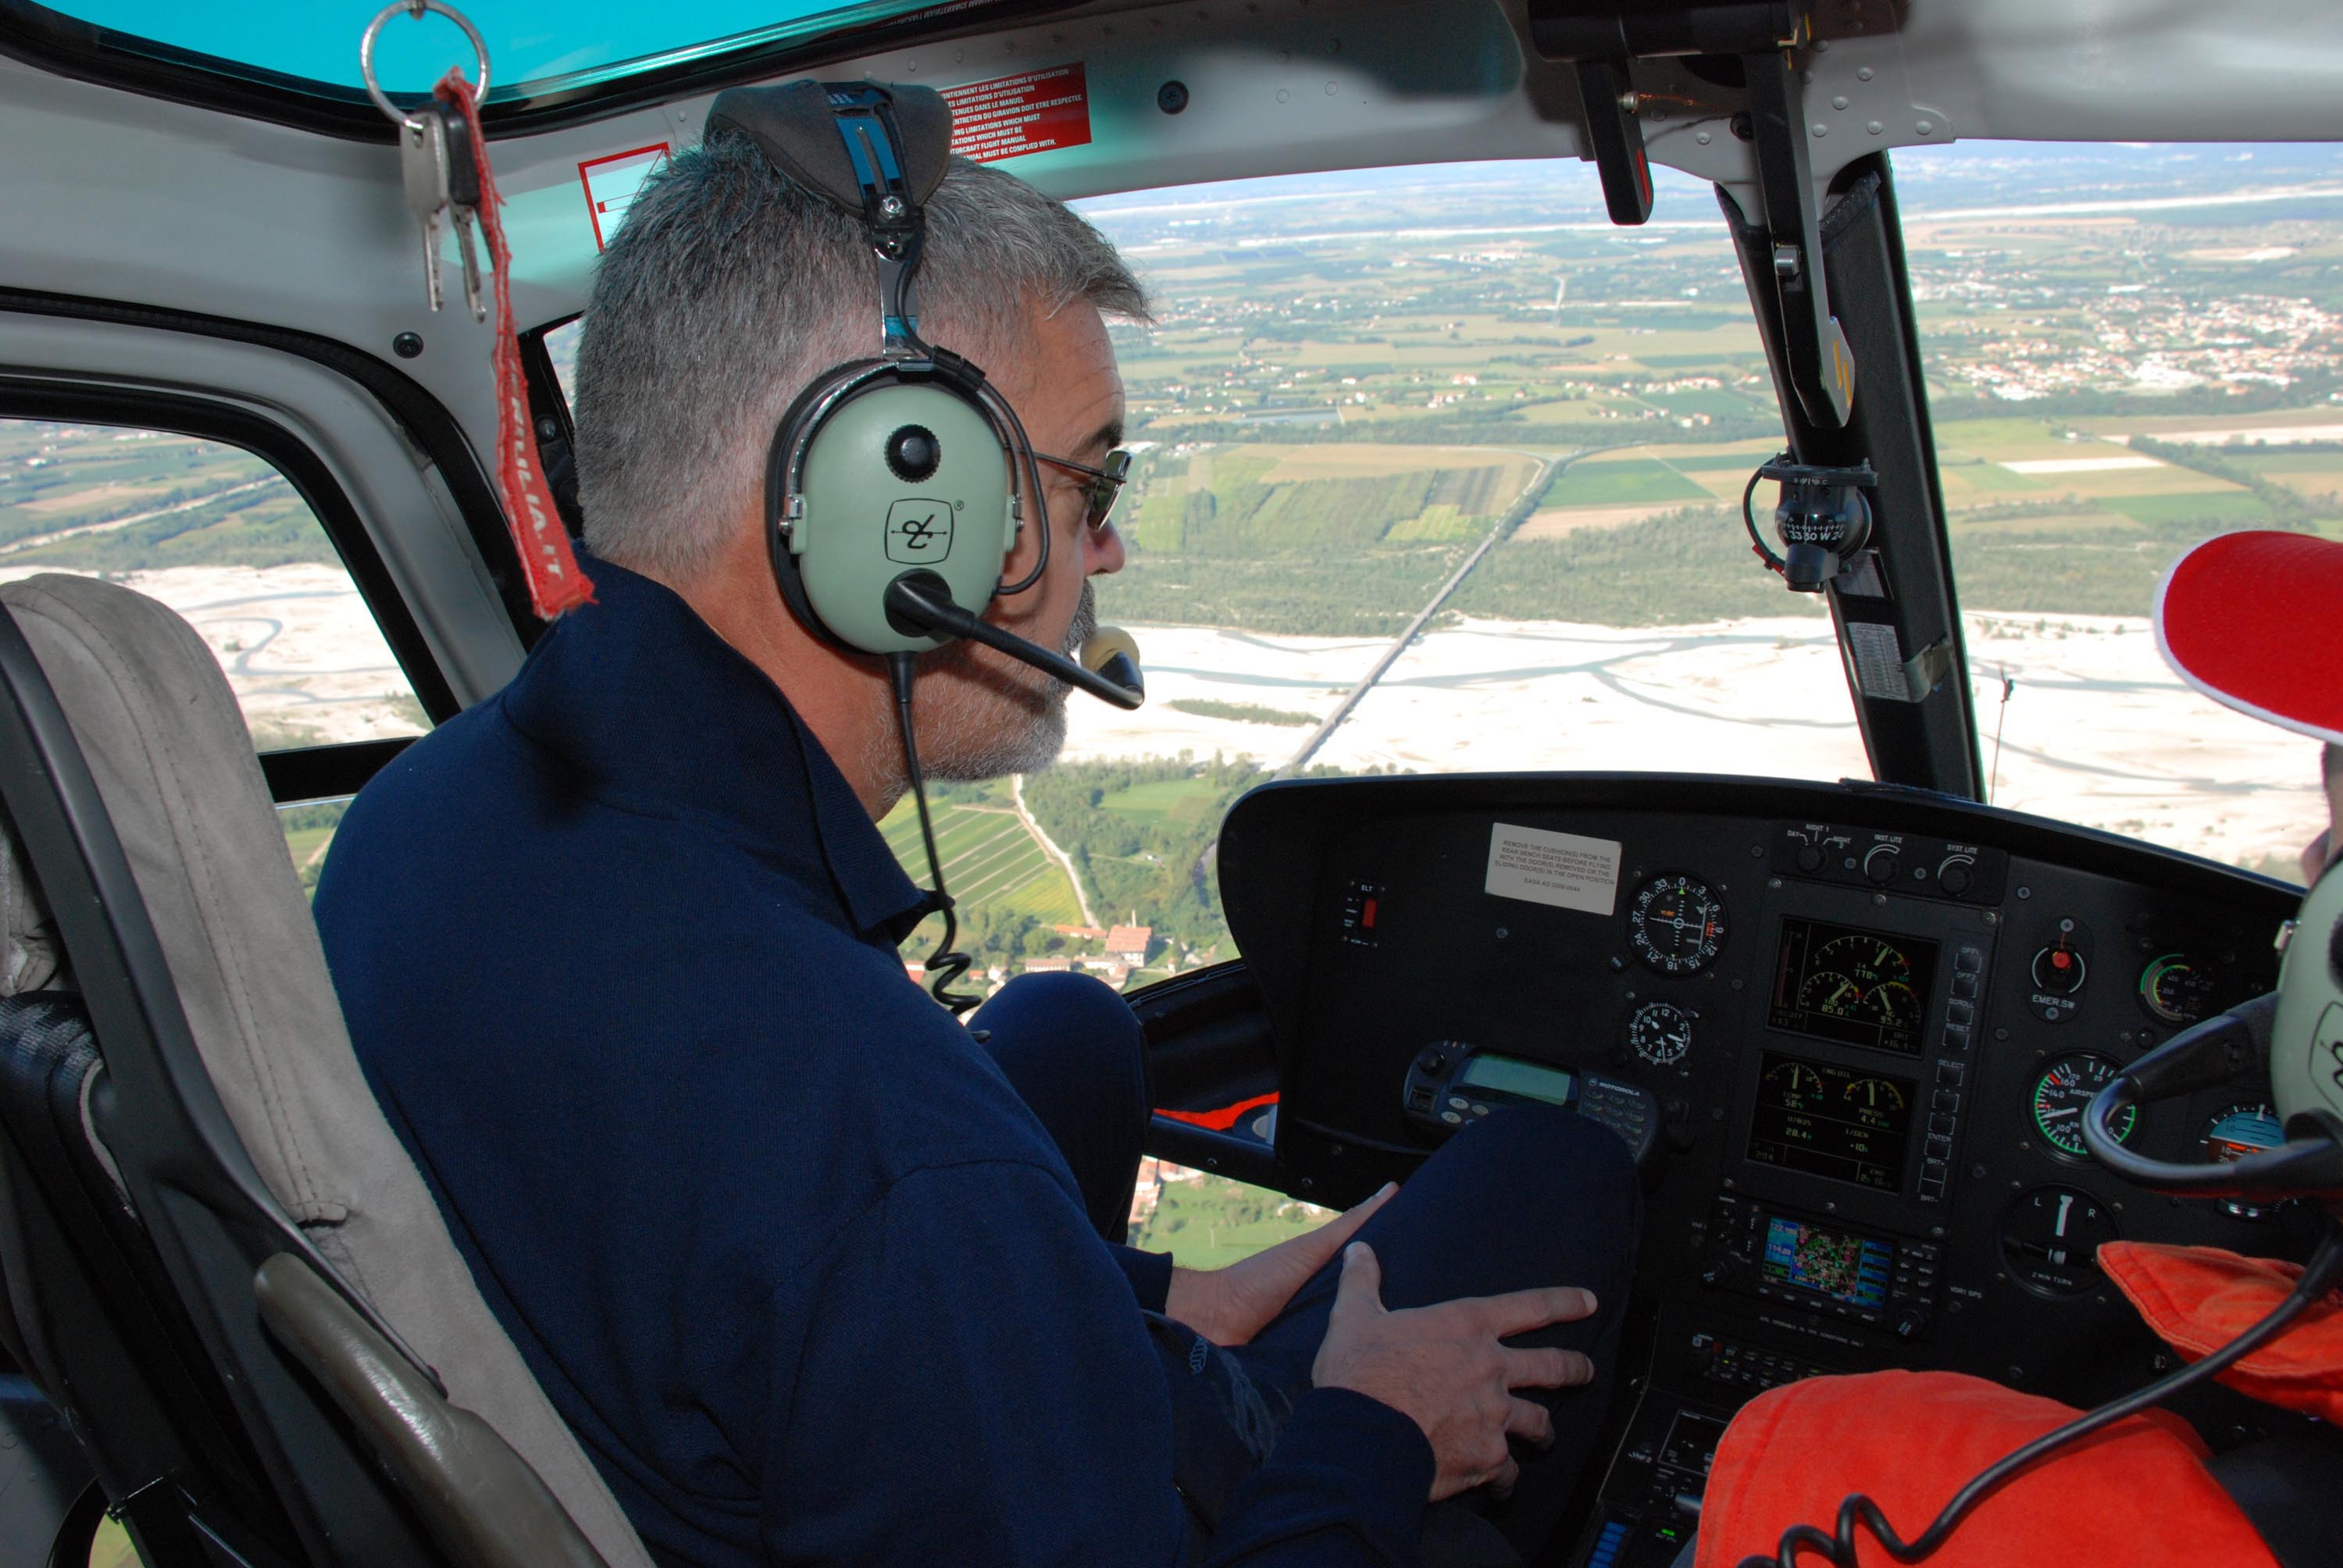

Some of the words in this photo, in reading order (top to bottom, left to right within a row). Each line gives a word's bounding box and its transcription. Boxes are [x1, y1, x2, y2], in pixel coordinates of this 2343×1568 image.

[979, 84, 990, 93] LES
[990, 77, 1027, 91] LIMITATIONS
[1027, 67, 1069, 84] D'UTILISATION
[956, 93, 993, 105] LIMITATIONS
[993, 84, 1035, 99] D'UTILISATION
[974, 104, 991, 113] DANS
[992, 102, 999, 110] LE
[999, 96, 1025, 107] MANUEL
[982, 111, 992, 119] DU
[992, 105, 1021, 118] GIRAVION
[1021, 102, 1035, 113] DOIT
[1036, 99, 1050, 110] ETRE
[965, 120, 1002, 134] LIMITATIONS
[1003, 115, 1023, 127] WHICH
[1023, 112, 1041, 123] MUST
[976, 130, 997, 142] WHICH
[997, 128, 1014, 139] MUST
[1014, 125, 1023, 134] BE
[981, 141, 1000, 151] FLIGHT
[1000, 135, 1026, 146] MANUAL
[982, 147, 1000, 159] MUST
[1000, 144, 1009, 155] BE
[1008, 141, 1038, 154] COMPLIED
[1788, 531, 1803, 540] 33
[1819, 532, 1831, 541] W
[1805, 824, 1823, 832] NIGHT
[1503, 839, 1528, 850] REMOVE
[1579, 852, 1598, 861] FROM
[1599, 855, 1611, 864] THE
[1501, 846, 1519, 855] REAR
[1519, 850, 1541, 859] BENCH
[1542, 853, 1562, 863] SEATS
[1562, 856, 1588, 866] BEFORE
[1588, 861, 1611, 871] FLYING
[1500, 853, 1515, 862] WITH
[1555, 863, 1586, 874] REMOVED
[1597, 869, 1610, 878] THE
[1494, 860, 1518, 870] SLIDING
[1567, 871, 1585, 881] OPEN
[1585, 875, 1615, 886] POSITION
[1653, 878, 1668, 890] 33
[1638, 891, 1651, 904] 30
[1632, 911, 1642, 924] 27
[1633, 932, 1647, 946] 24
[1666, 960, 1678, 971] 18
[1660, 1008, 1670, 1017] 12
[1642, 1015, 1652, 1025] 10
[1678, 1023, 1686, 1032] 2
[2059, 1078, 2077, 1087] 160
[1598, 1082, 1641, 1097] MOTOROLA
[2049, 1089, 2066, 1099] 140
[2056, 1124, 2071, 1134] 100
[2107, 1126, 2114, 1135] 0
[2034, 1196, 2042, 1207] L
[2087, 1208, 2096, 1219] R
[2037, 1273, 2051, 1282] MIN
[2052, 1276, 2074, 1286] TURN
